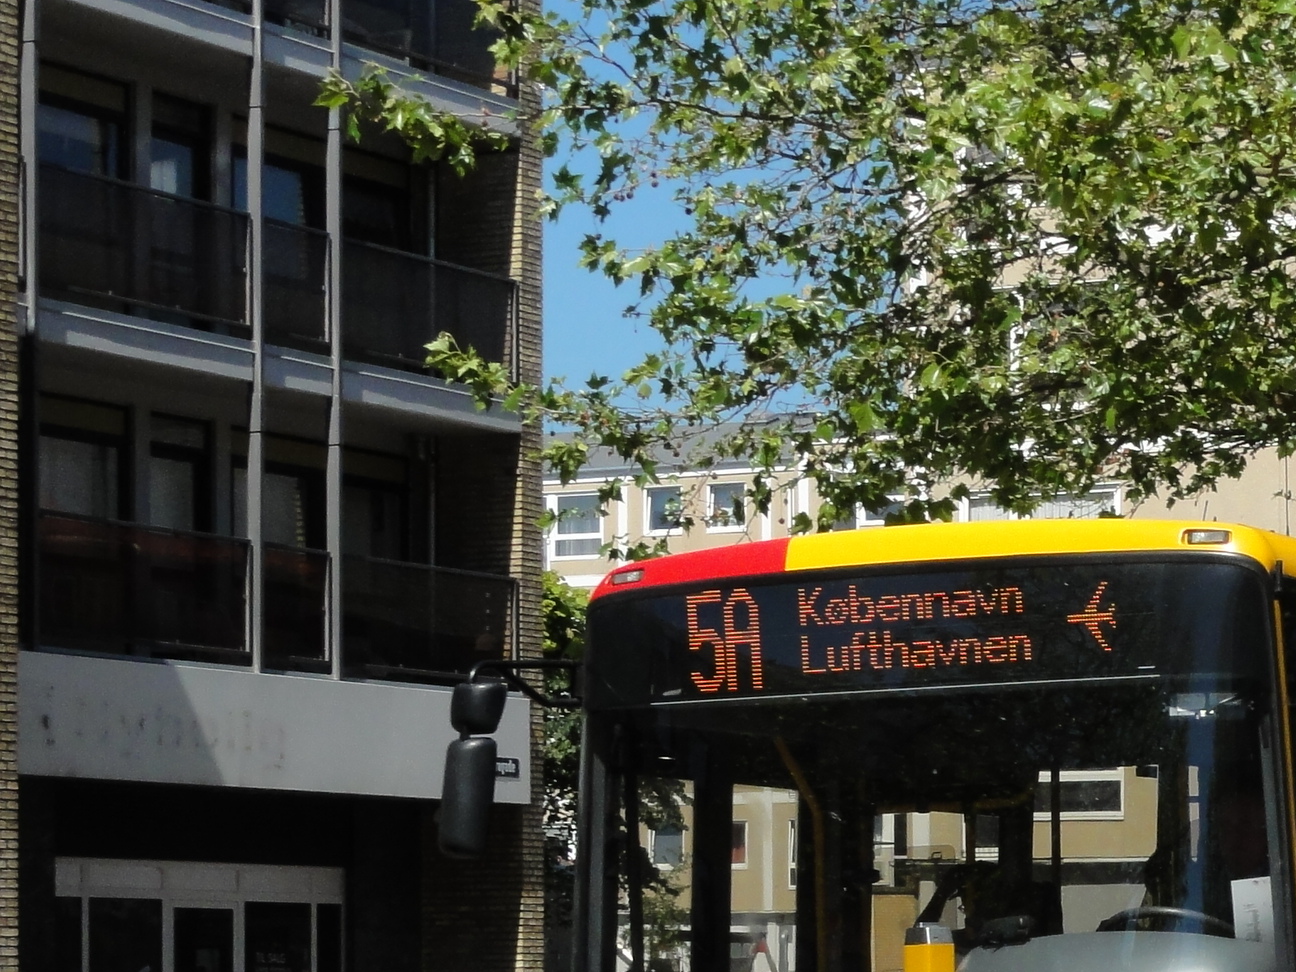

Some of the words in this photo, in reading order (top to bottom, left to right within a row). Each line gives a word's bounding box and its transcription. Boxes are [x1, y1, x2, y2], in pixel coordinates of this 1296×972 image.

[799, 584, 1024, 626] København
[686, 587, 764, 692] 5A
[800, 629, 1033, 675] Lufthavnen
